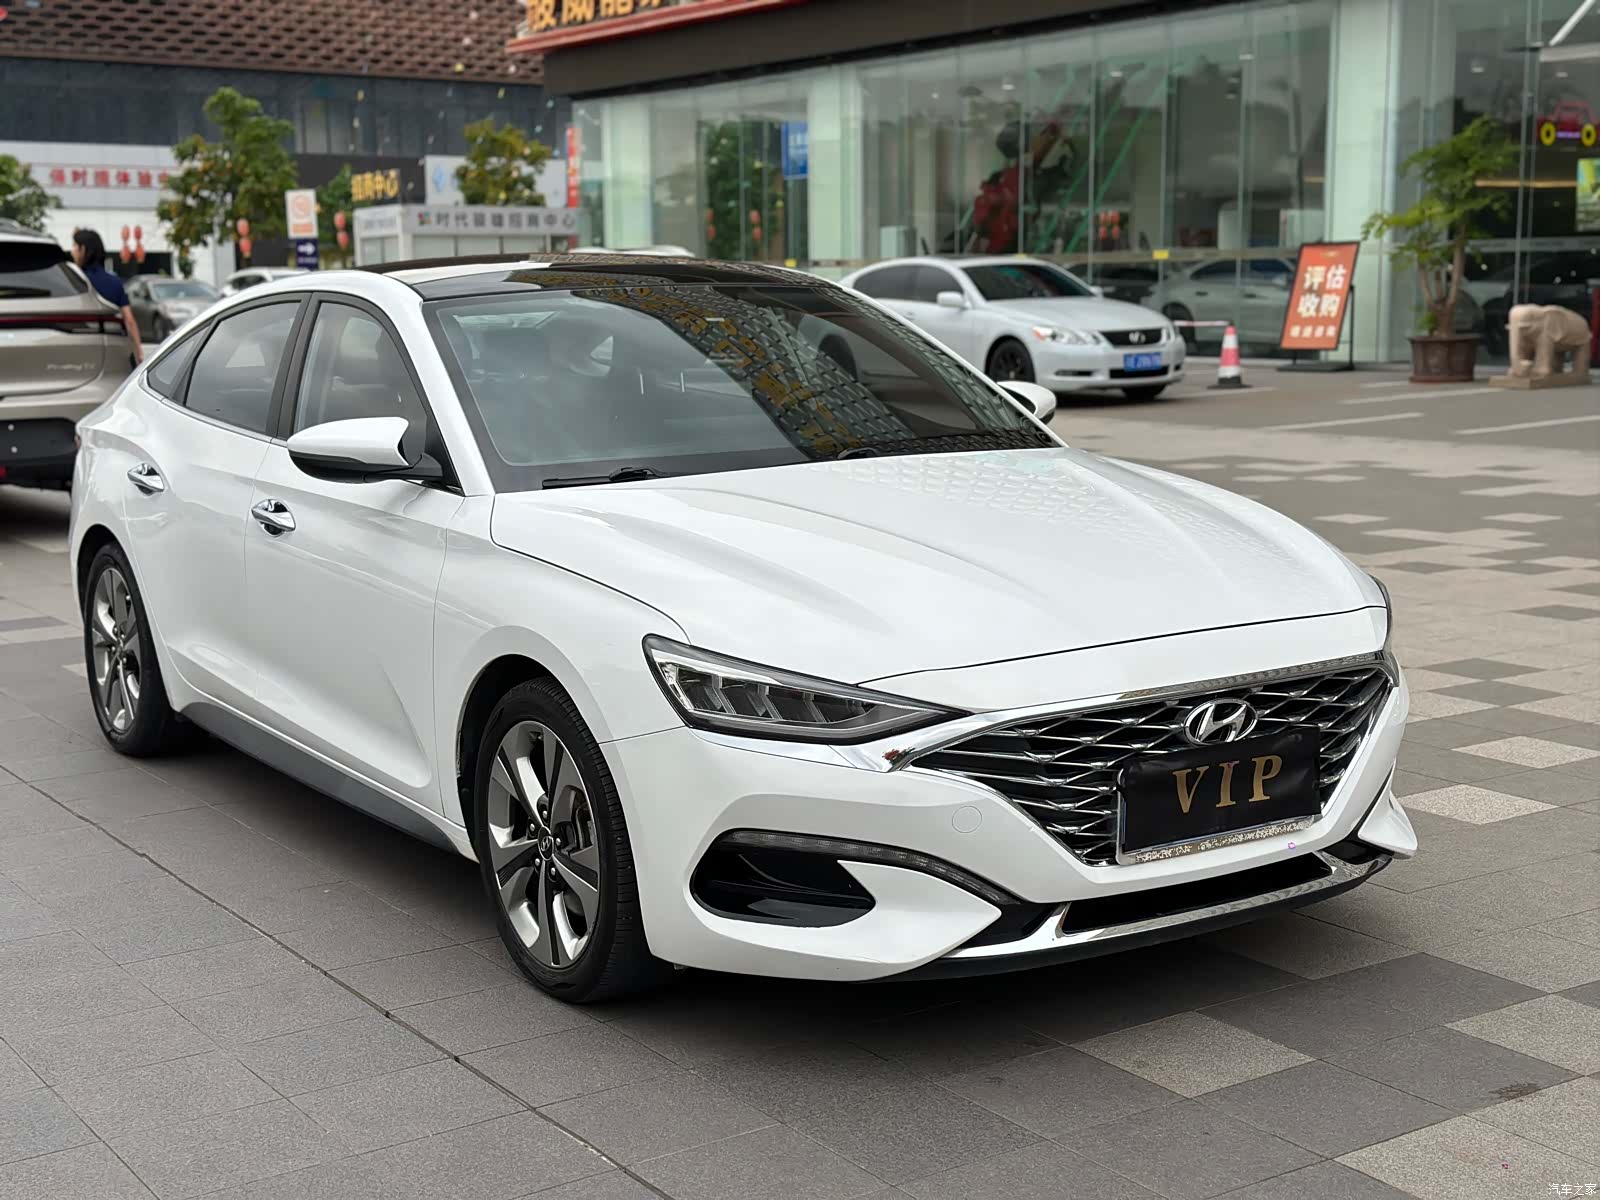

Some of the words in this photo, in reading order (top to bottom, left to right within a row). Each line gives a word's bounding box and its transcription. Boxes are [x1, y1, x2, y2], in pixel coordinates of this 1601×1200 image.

[1303, 263, 1347, 291] 评估
[1297, 292, 1341, 319] 收购
[1172, 754, 1283, 814] VIP
